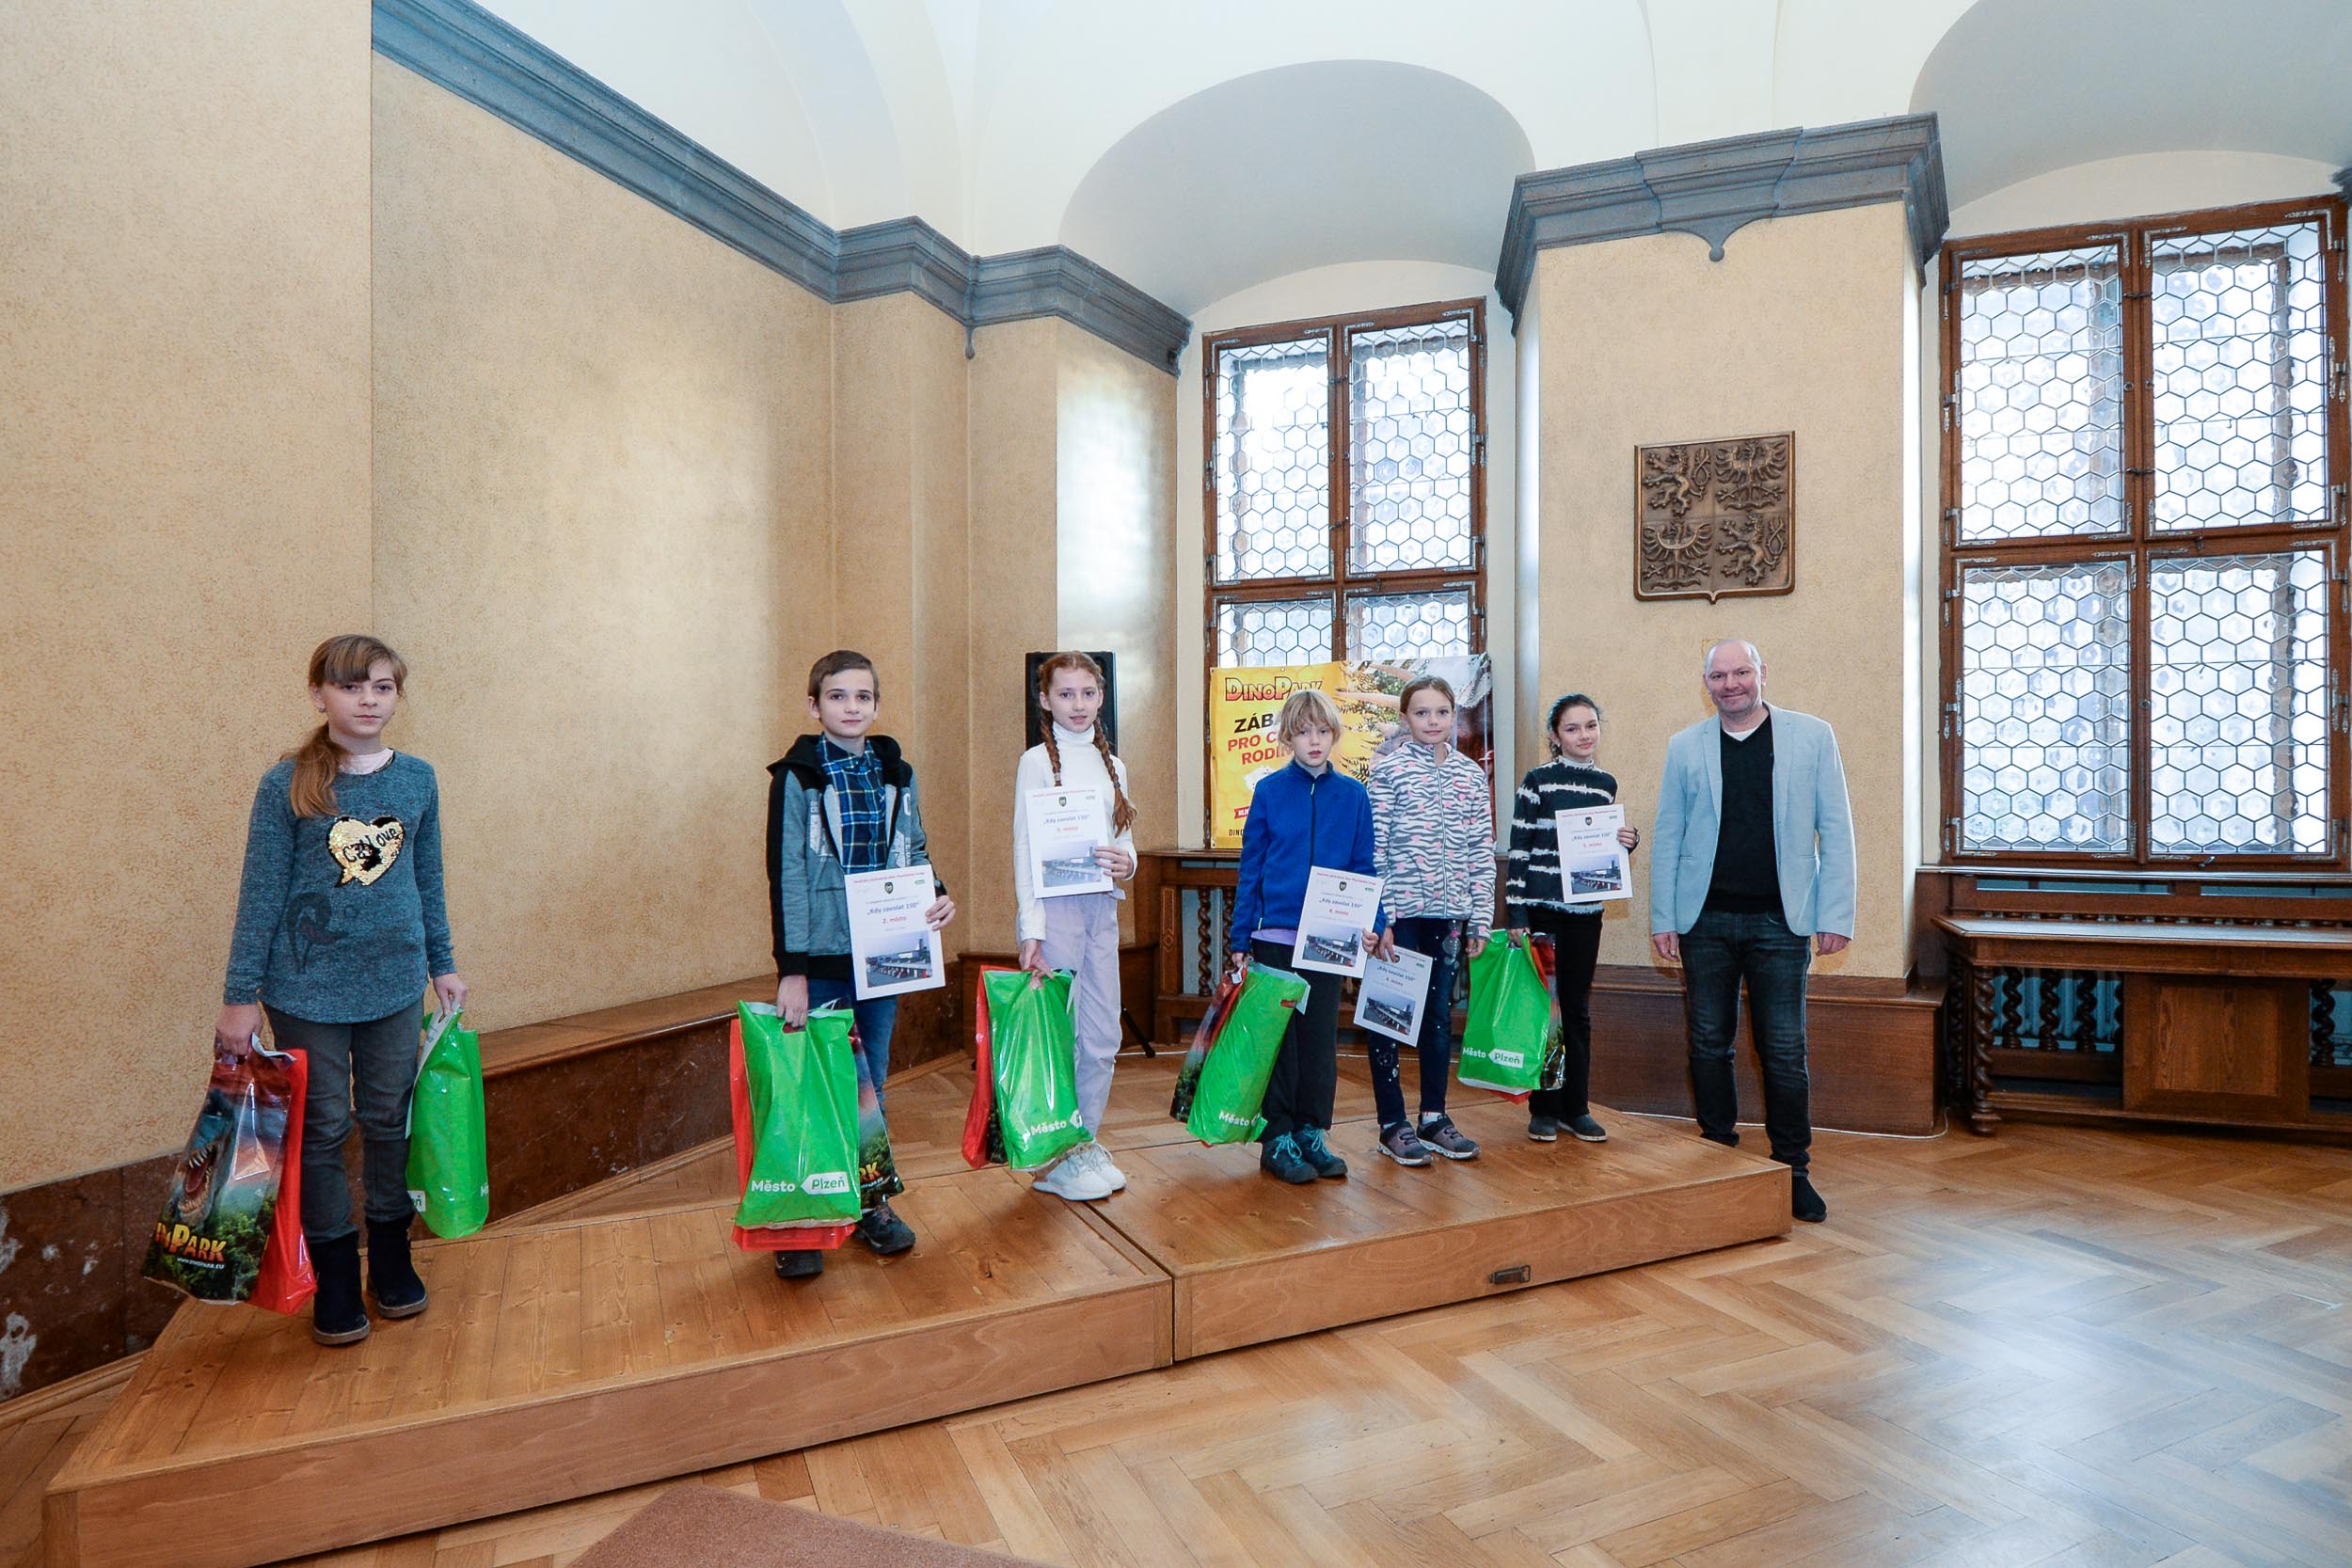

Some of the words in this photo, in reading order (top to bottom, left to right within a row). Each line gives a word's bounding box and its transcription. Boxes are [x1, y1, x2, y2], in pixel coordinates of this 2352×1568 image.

[1233, 713, 1276, 734] ZÁB
[1228, 734, 1262, 752] PRO
[1462, 1047, 1486, 1058] Město
[1218, 1110, 1250, 1127] Město
[1030, 1119, 1067, 1136] Město
[751, 1179, 796, 1193] Město
[811, 1176, 845, 1190] Plzeň
